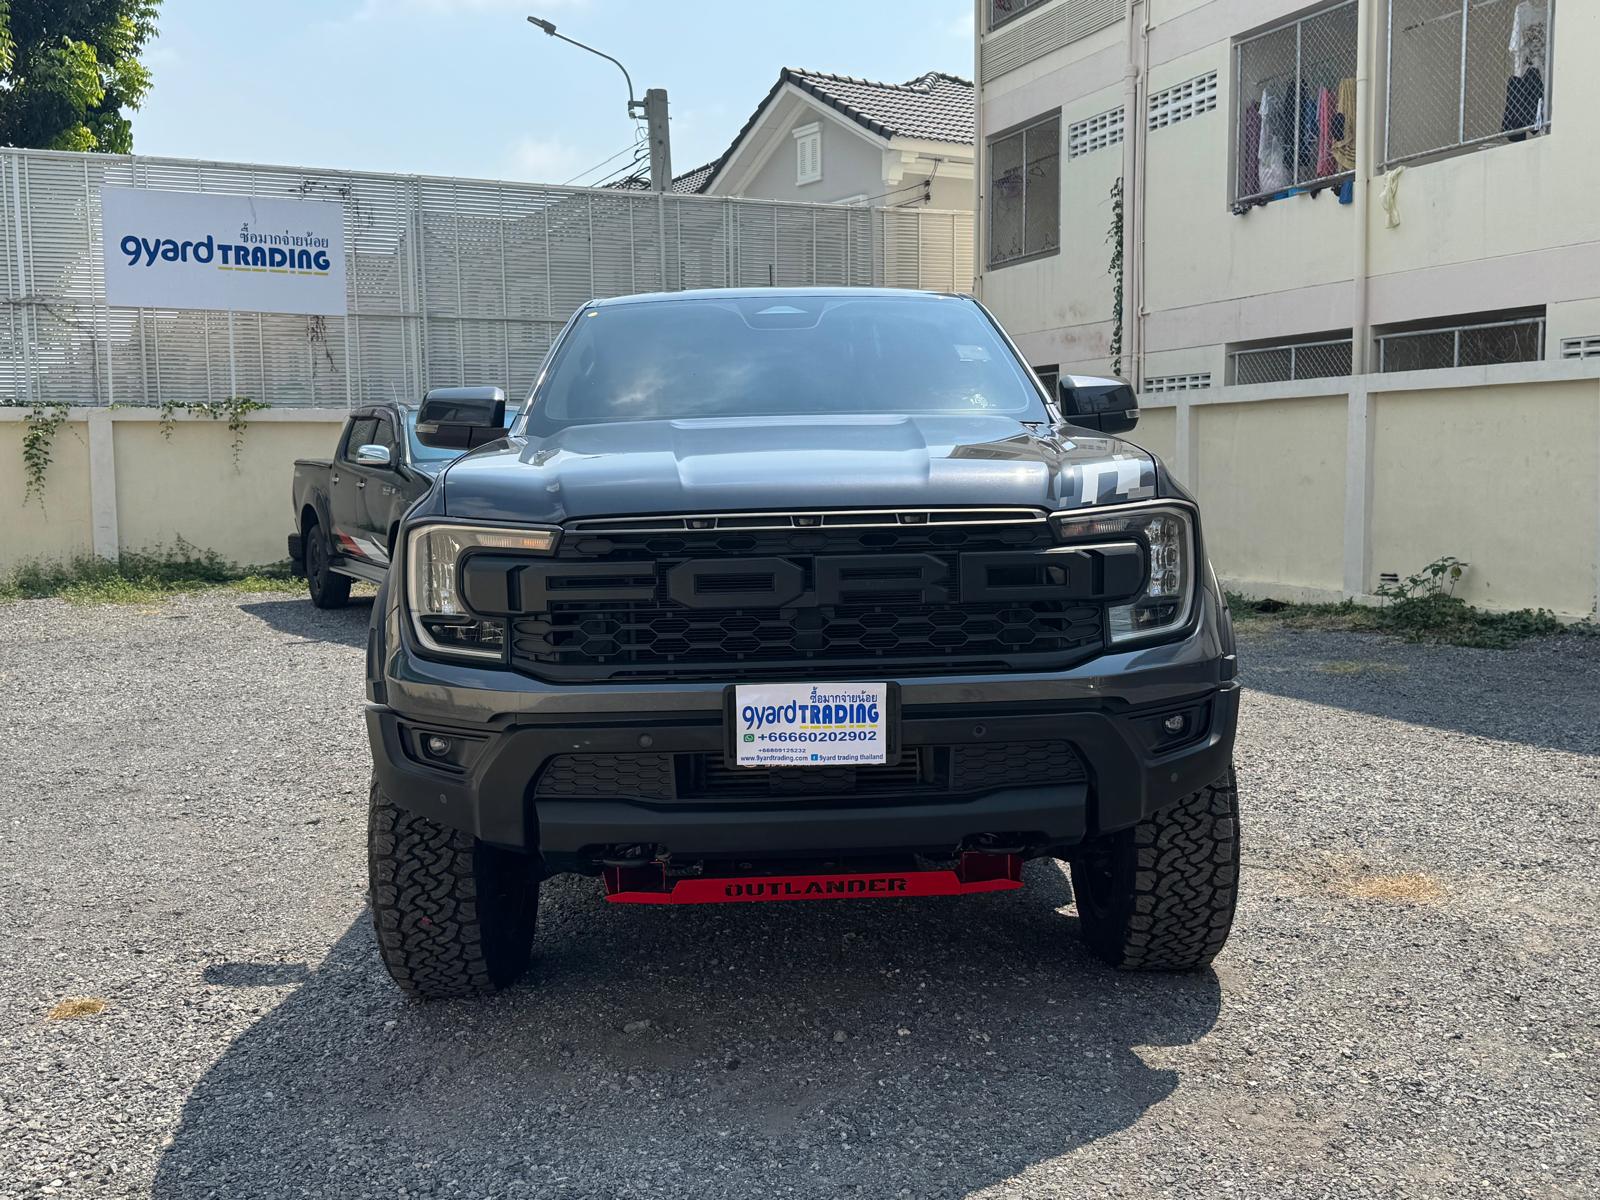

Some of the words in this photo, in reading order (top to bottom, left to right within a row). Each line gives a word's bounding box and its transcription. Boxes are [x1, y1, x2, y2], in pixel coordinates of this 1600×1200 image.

[239, 223, 329, 248] ซื้อมากจ่ายน้อย
[120, 235, 214, 267] 9yard
[217, 244, 330, 271] TRADING
[809, 686, 878, 704] ซื้อมากจ่ายน้อย
[742, 700, 797, 730] 9yard
[798, 703, 879, 725] TRADING
[758, 731, 877, 742] +66660202902
[740, 754, 808, 762] www.9yardtrading.com
[819, 754, 837, 762] 9yard
[837, 753, 859, 761] trading
[725, 878, 908, 897] OUTLANDER
